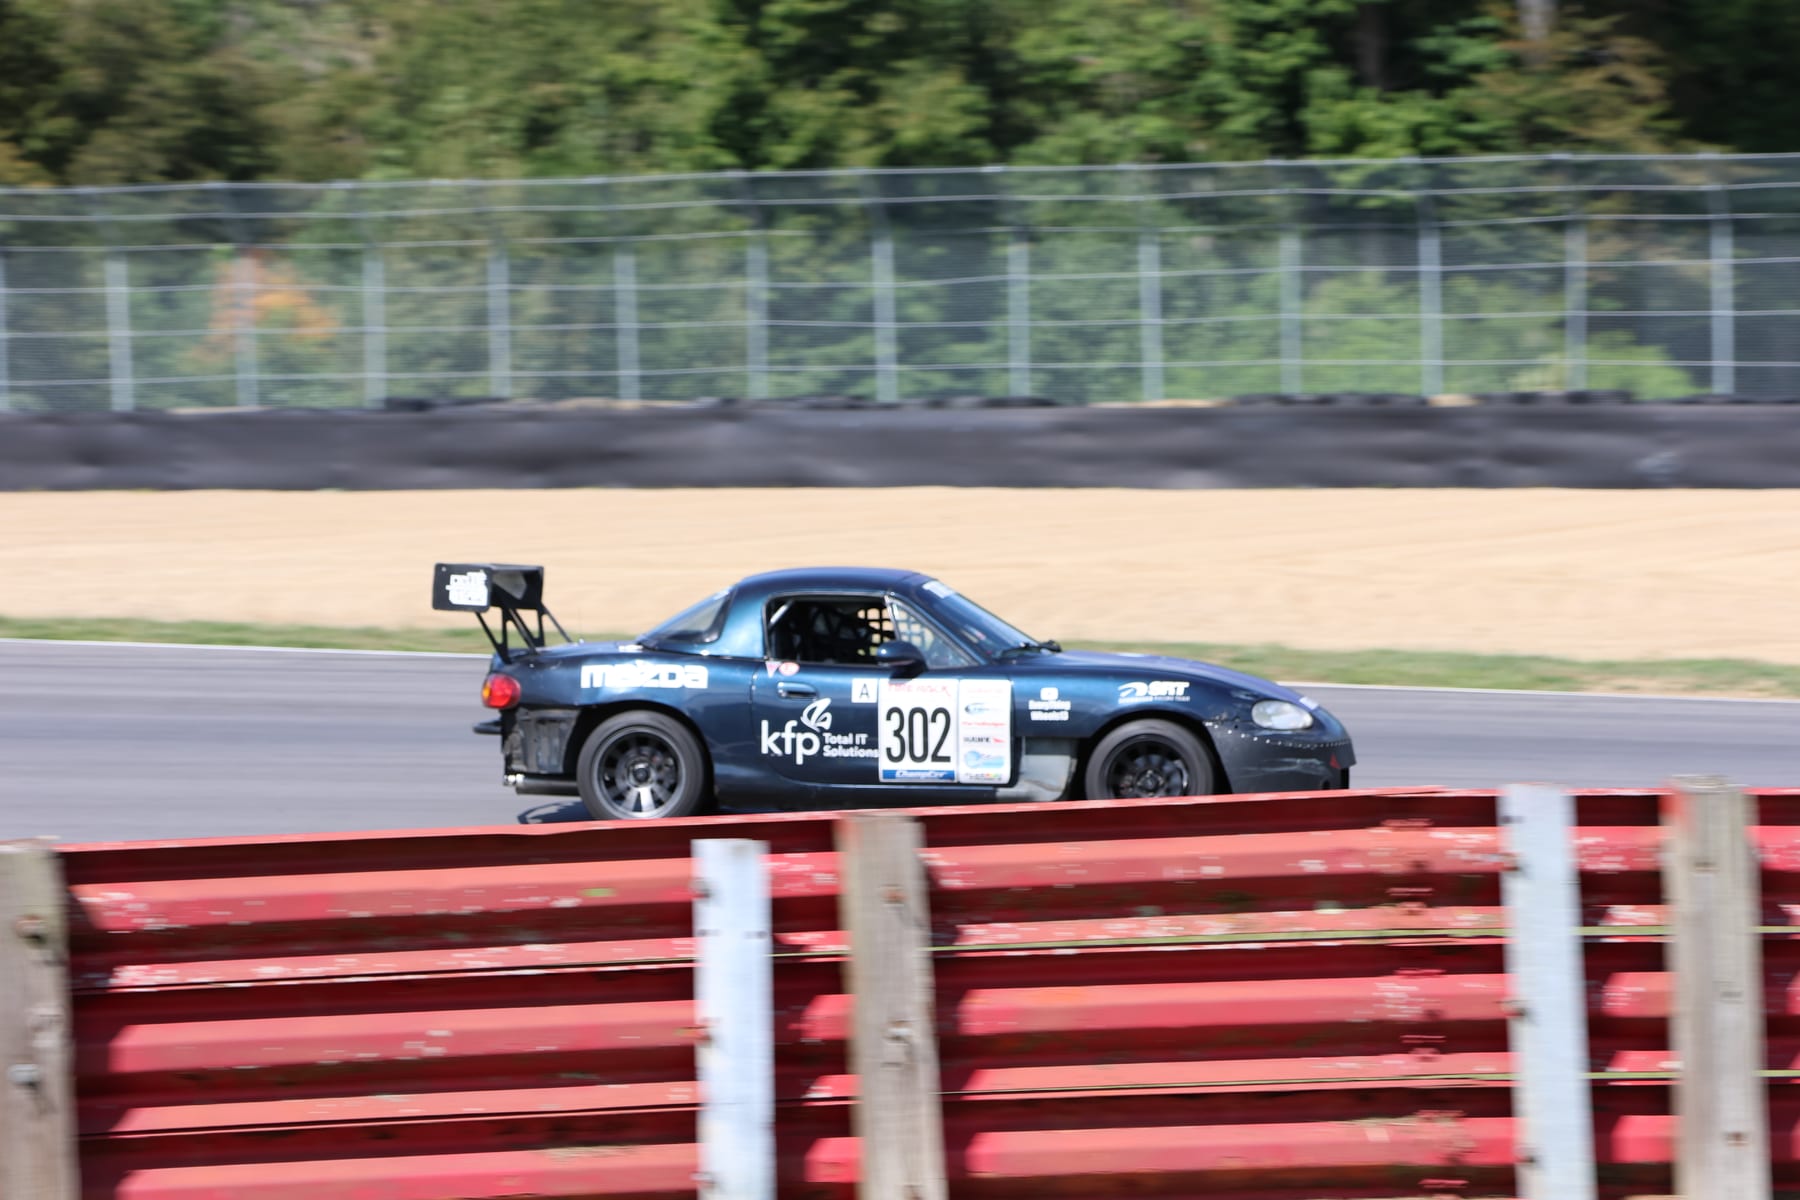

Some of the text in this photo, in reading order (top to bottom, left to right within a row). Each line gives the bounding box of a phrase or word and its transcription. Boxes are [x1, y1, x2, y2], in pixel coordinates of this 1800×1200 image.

[581, 661, 708, 689] mazda
[859, 683, 870, 699] A
[761, 720, 820, 765] kfp
[822, 732, 869, 745] Total IT
[886, 707, 951, 763] 302
[823, 745, 880, 758] Solutions
